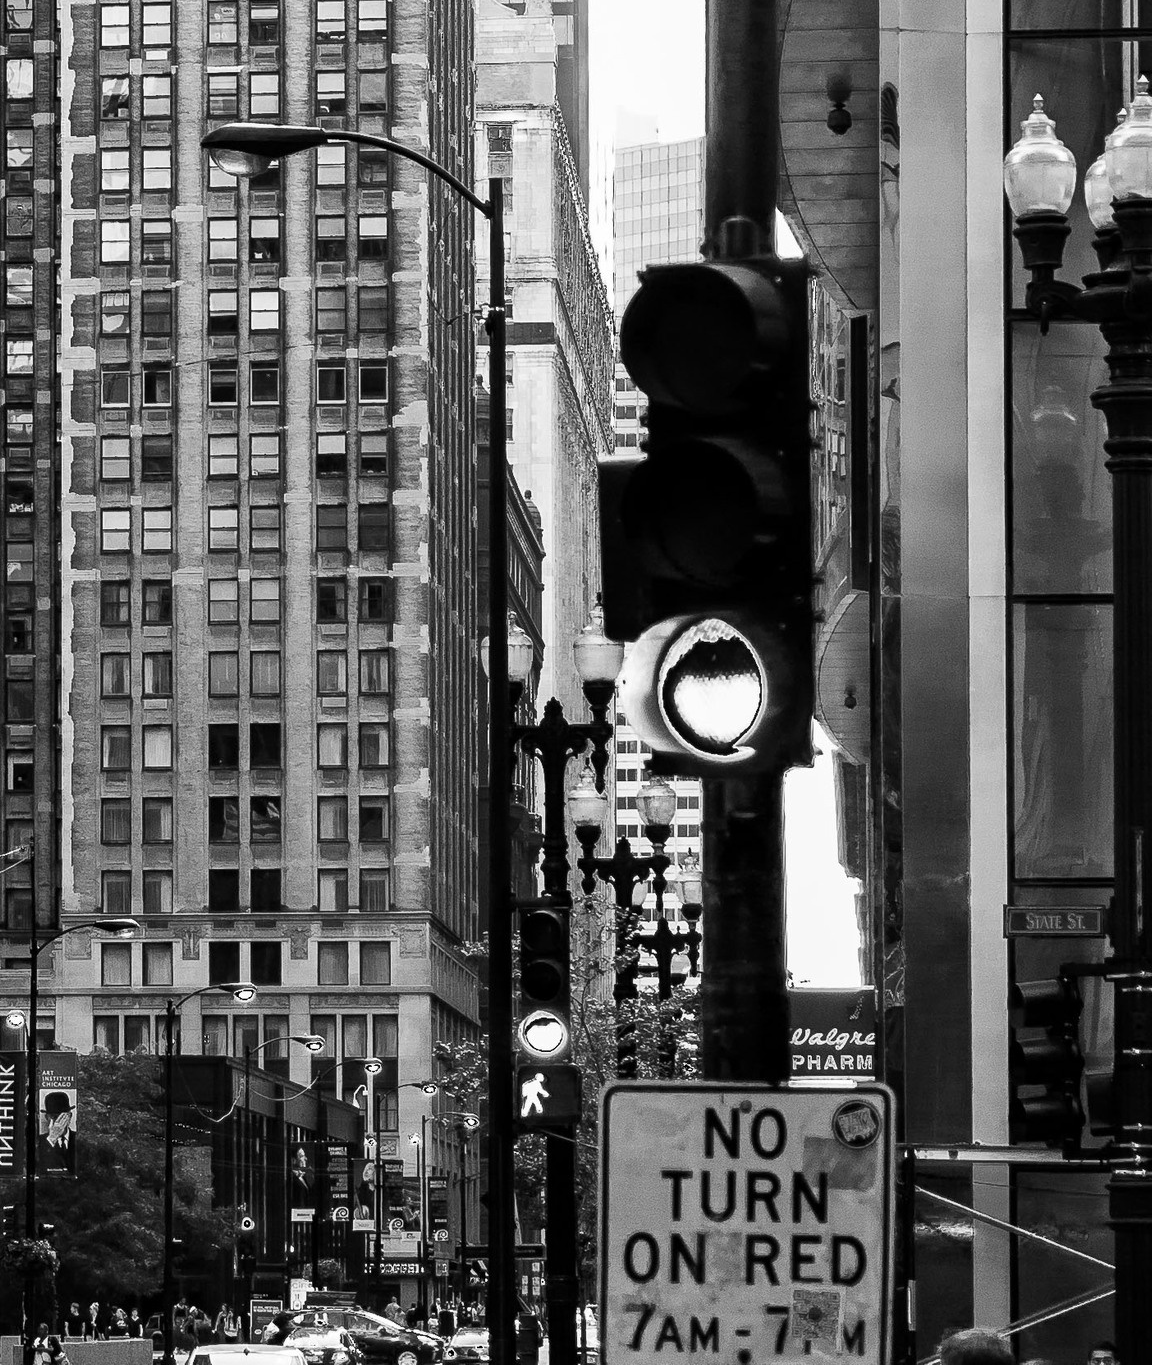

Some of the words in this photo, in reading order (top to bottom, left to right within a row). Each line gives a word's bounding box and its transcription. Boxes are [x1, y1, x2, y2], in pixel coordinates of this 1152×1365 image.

[1026, 912, 1063, 930] STATE
[1067, 912, 1086, 930] ST.
[792, 1054, 873, 1070] PHARM
[704, 1107, 788, 1160] NO
[660, 1170, 828, 1224] TURN
[623, 1231, 706, 1284] ON
[745, 1233, 867, 1287] RED
[623, 1302, 719, 1353] 7AM
[765, 1305, 866, 1356] 7M
